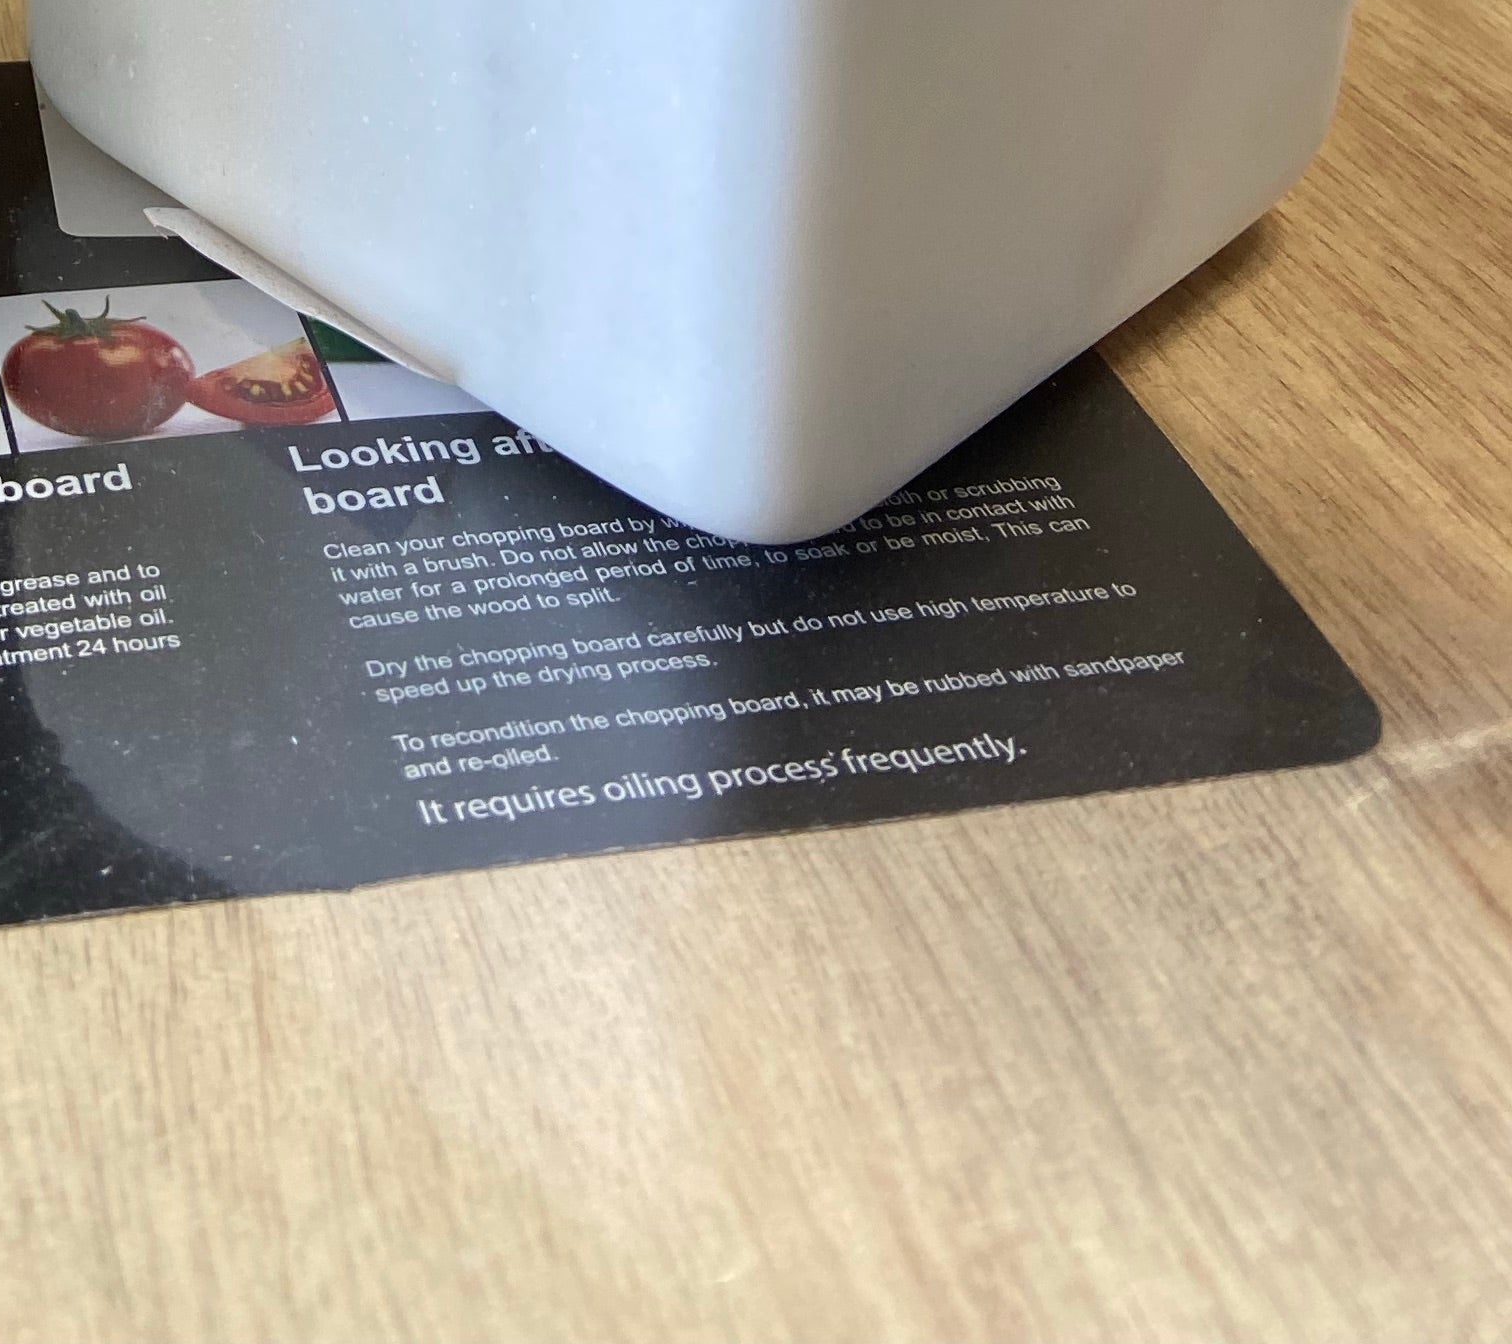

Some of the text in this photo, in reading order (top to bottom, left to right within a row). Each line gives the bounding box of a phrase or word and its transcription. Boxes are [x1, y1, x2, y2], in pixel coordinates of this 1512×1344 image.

[288, 436, 481, 472] Looking
[303, 476, 445, 514] board
[323, 542, 391, 559] Clean
[395, 536, 445, 556] your
[452, 526, 555, 547] chopping
[558, 518, 624, 538] board
[627, 517, 654, 534] by
[953, 475, 1062, 499] scrubbing
[331, 567, 346, 582] it
[350, 562, 398, 580] with
[403, 563, 418, 575] a
[423, 553, 495, 573] brush.
[499, 550, 534, 565] Do
[540, 545, 578, 562] not
[582, 540, 639, 559] allow
[643, 538, 680, 552] the
[946, 499, 1028, 521] contact
[1028, 494, 1076, 512] with
[0, 574, 80, 597] grease
[88, 565, 130, 583] and
[138, 565, 160, 578] to
[339, 517, 1091, 605] water for a prolonged period of time, soak moist, This can
[84, 589, 131, 607] with
[349, 587, 620, 629] cause the wood to split.
[15, 613, 131, 639] vegetable
[140, 608, 173, 625] oil.
[366, 583, 1137, 678] Dry the chopping board carefully but do not use high temperature to
[76, 638, 107, 657] 24
[112, 635, 180, 653] hours
[375, 654, 718, 704] speed up the drying process.
[391, 652, 1184, 752] To recondition the chopping board, it may be rubbed with sandpaper
[404, 756, 452, 779] and
[419, 732, 1028, 824] It requires oiling process frequently.
